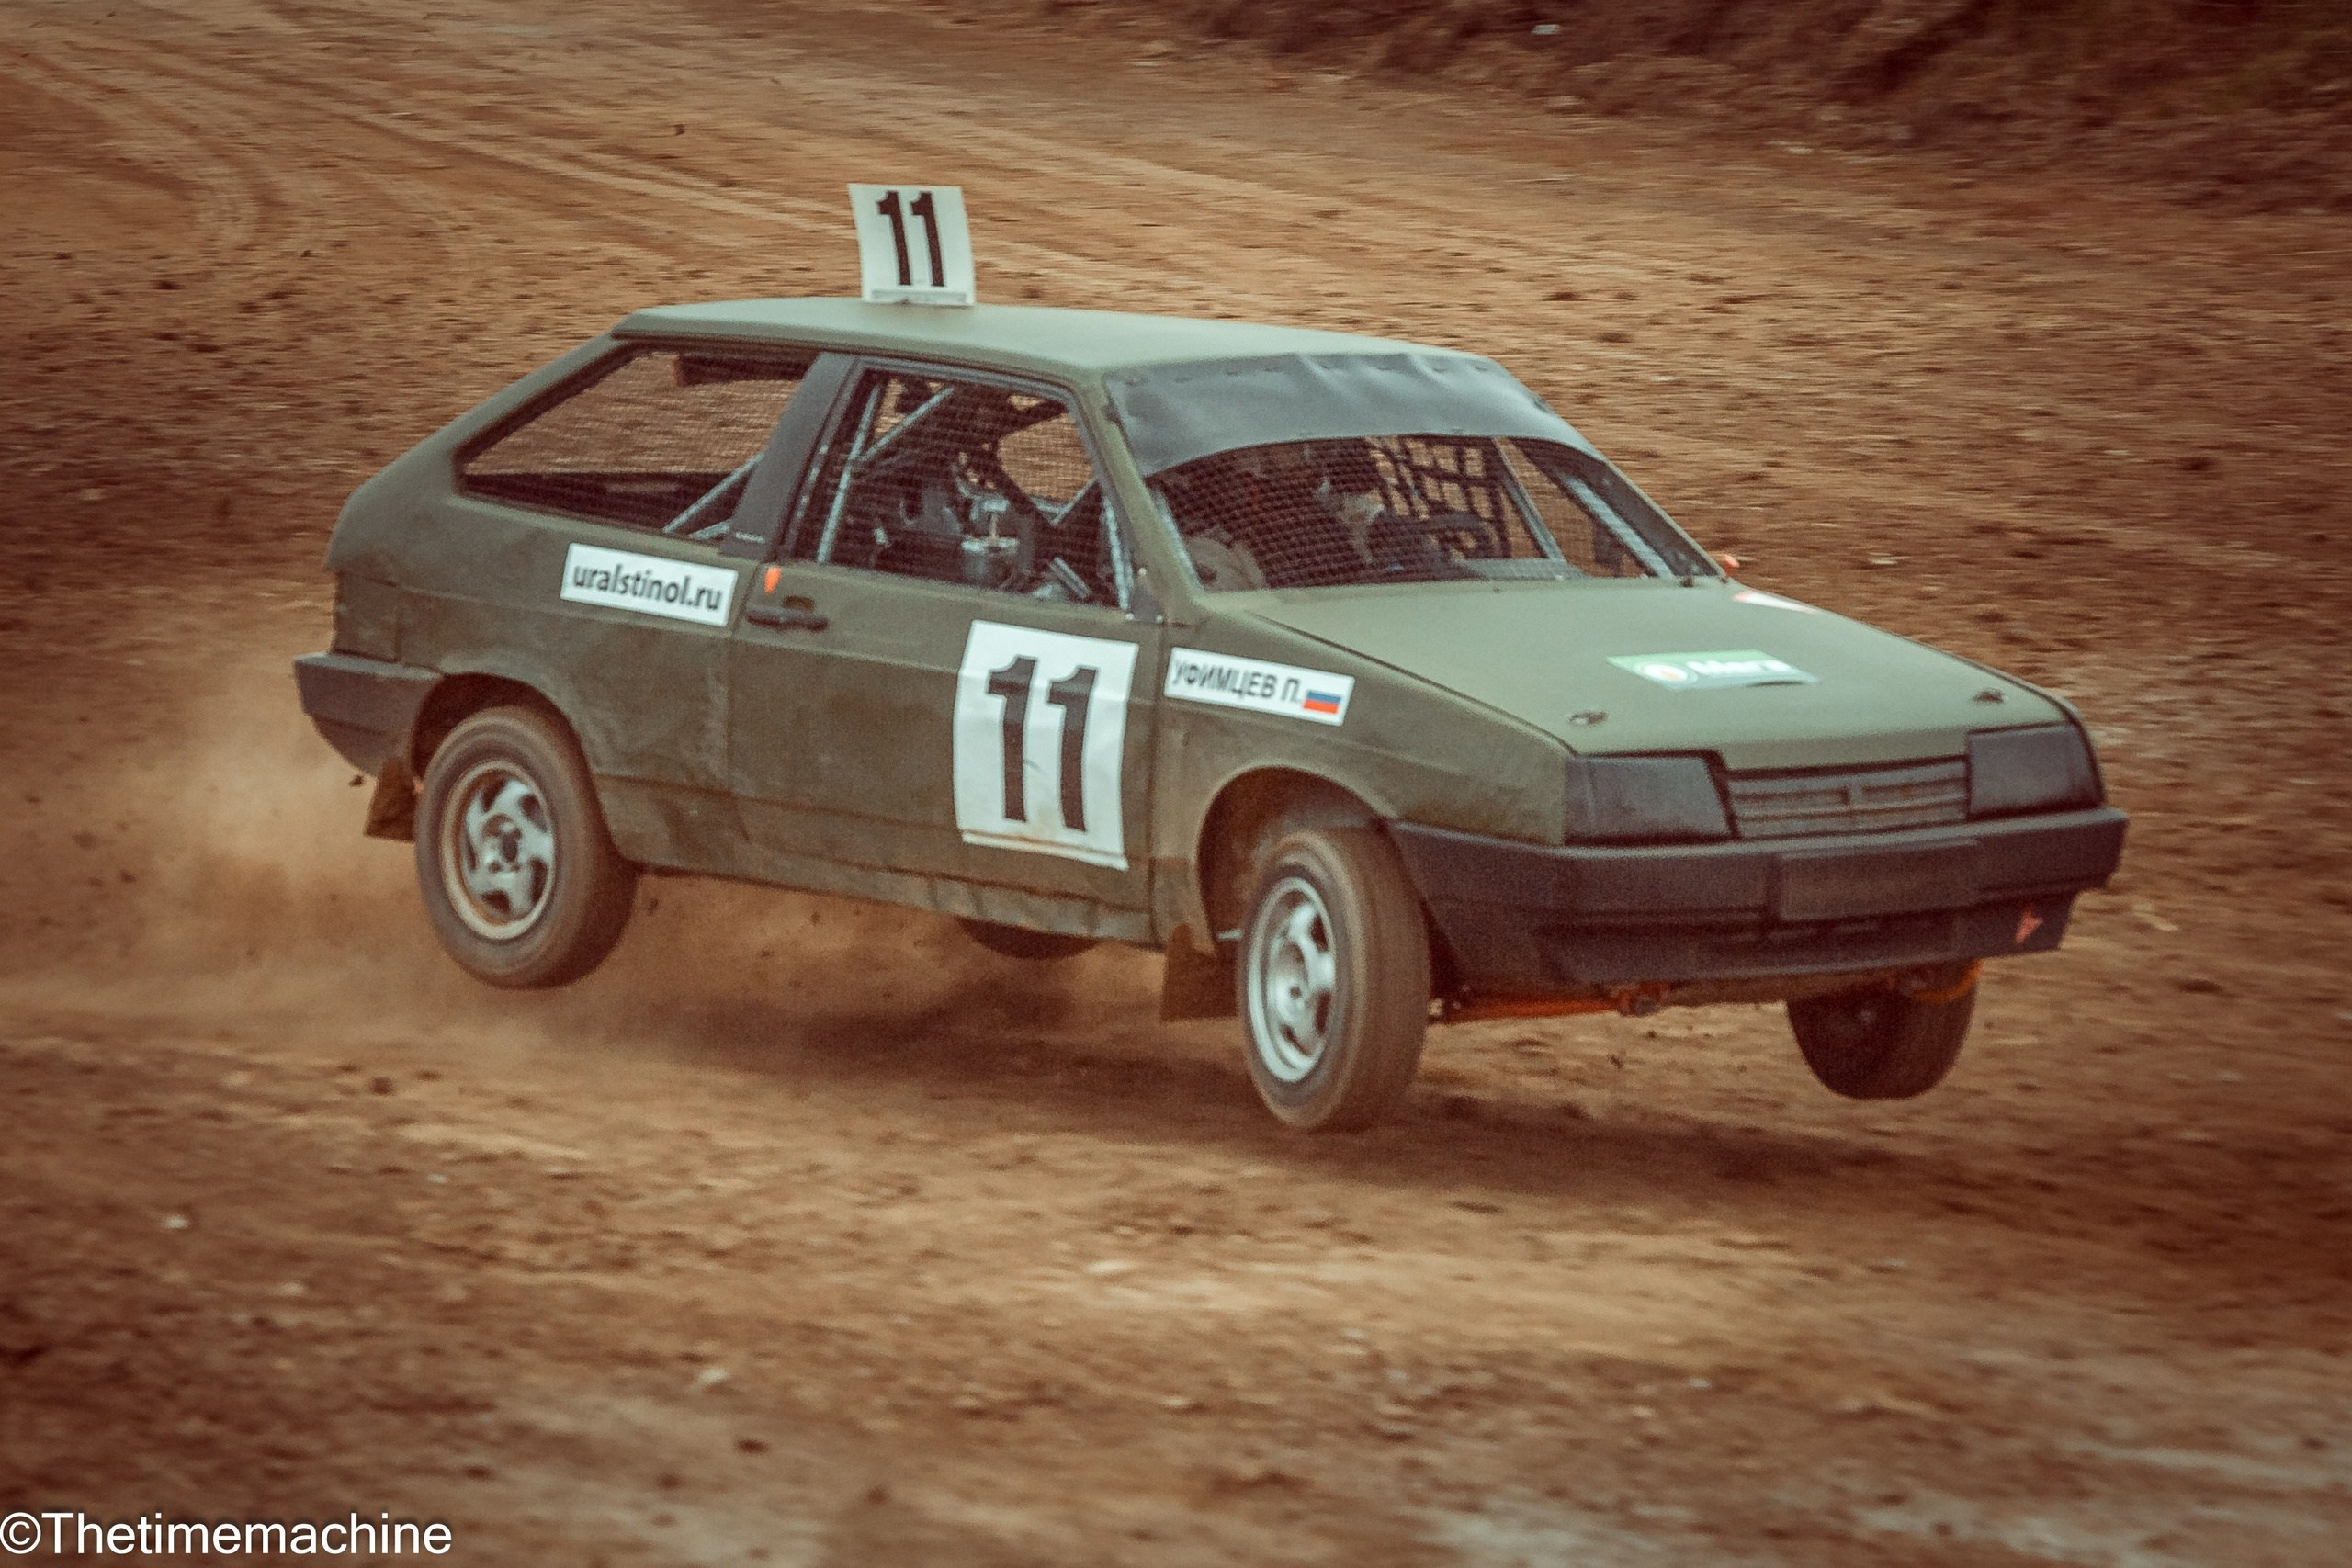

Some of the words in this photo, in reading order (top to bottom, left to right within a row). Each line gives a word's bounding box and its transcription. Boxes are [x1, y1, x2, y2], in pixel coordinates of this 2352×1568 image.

[876, 190, 945, 287] 11
[572, 563, 723, 611] uralstinol.ru
[1172, 659, 1278, 700] УФИМЦЕВ
[986, 654, 1099, 832] 11
